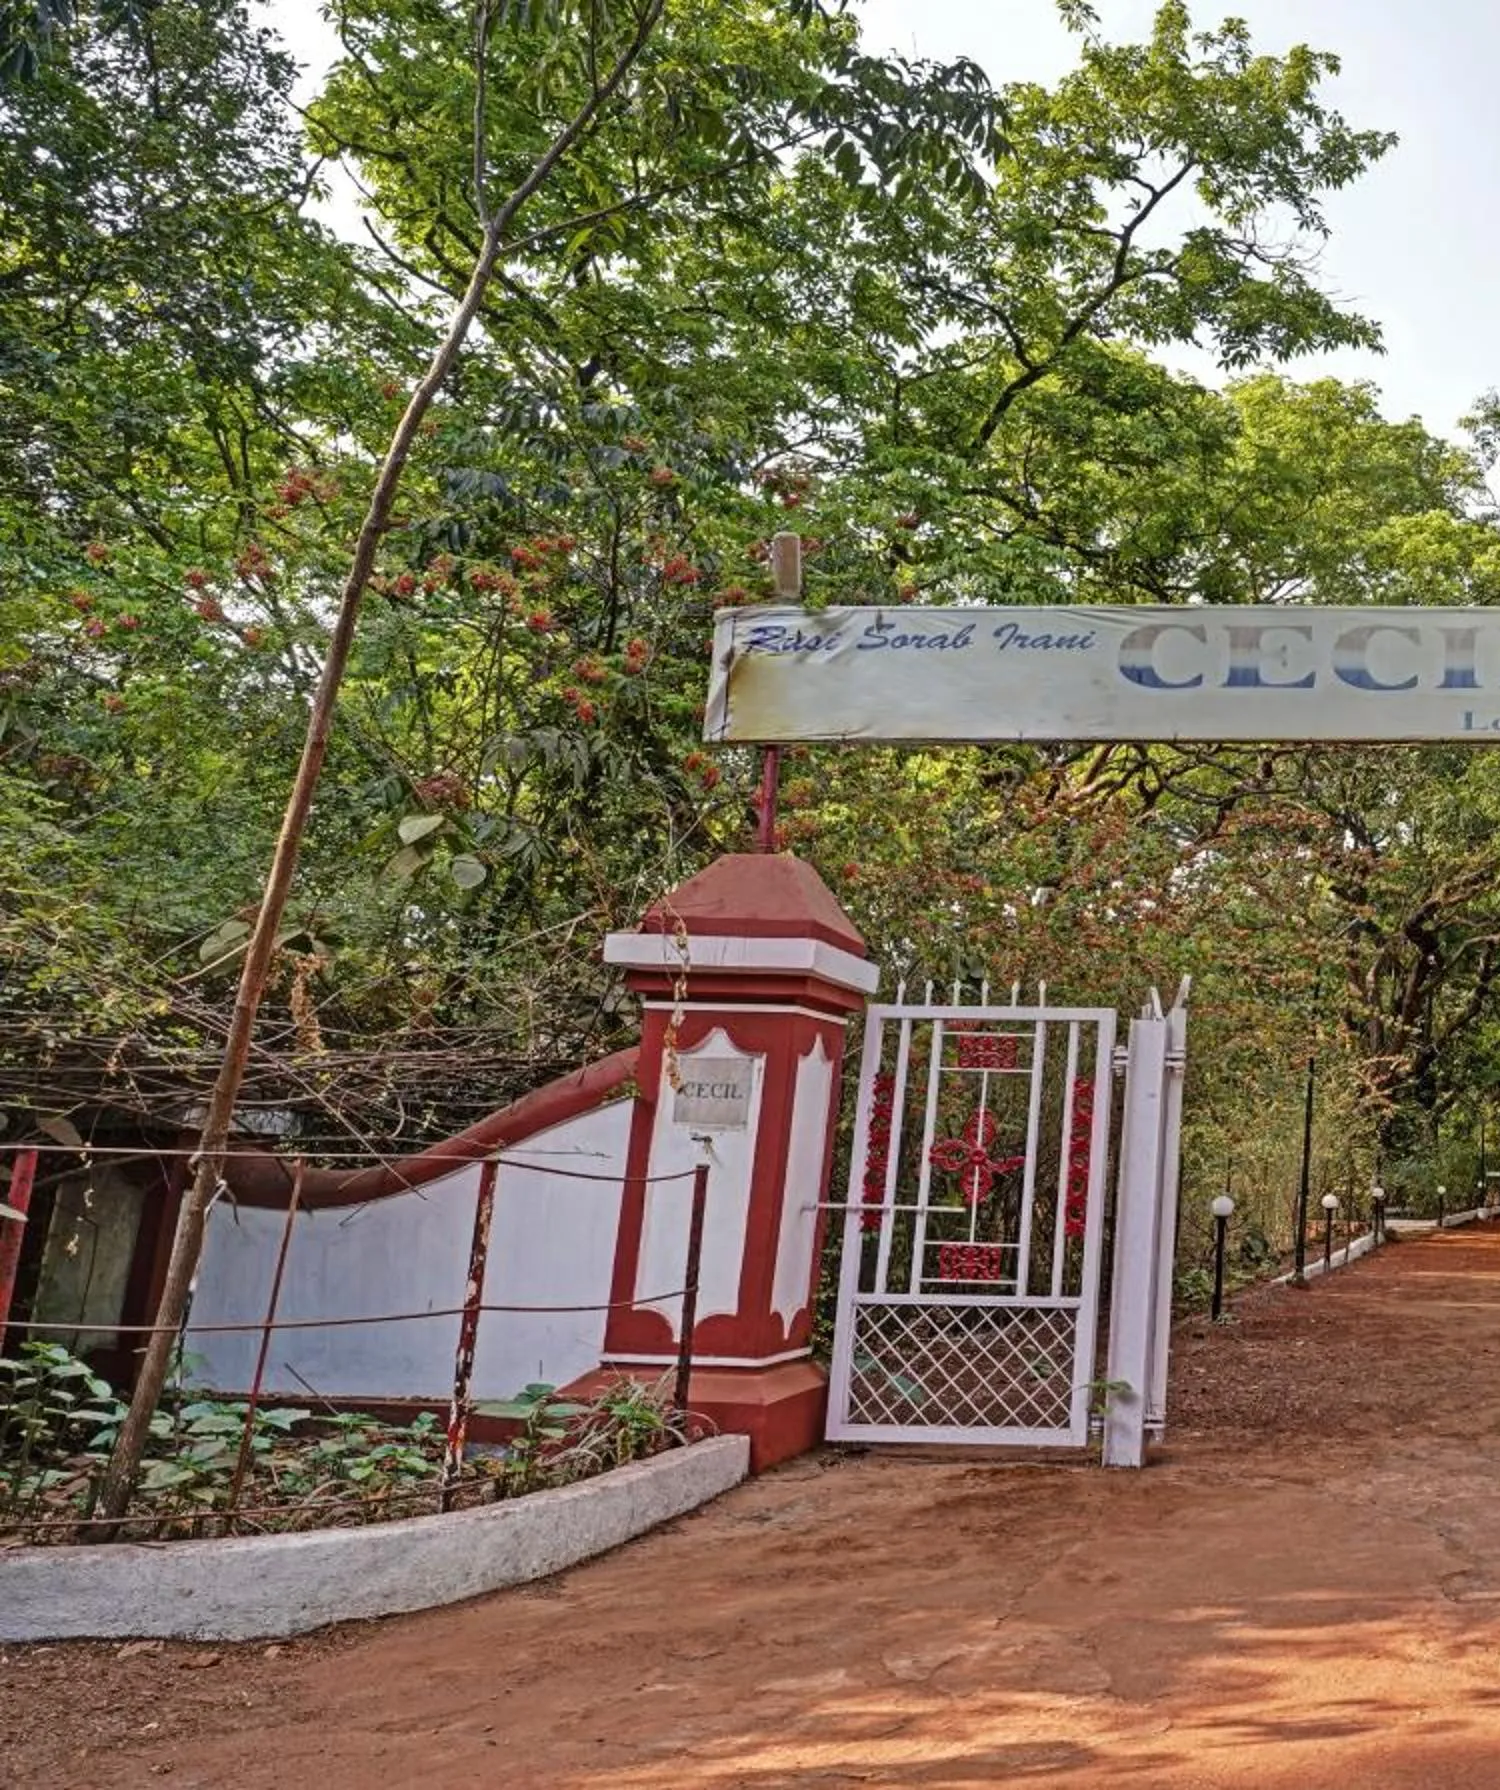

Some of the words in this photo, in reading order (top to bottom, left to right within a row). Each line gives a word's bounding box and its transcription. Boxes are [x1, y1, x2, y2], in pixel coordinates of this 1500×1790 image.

[856, 622, 976, 651] Sorab
[993, 622, 1097, 651] Irani
[682, 1081, 744, 1099] CECIL
